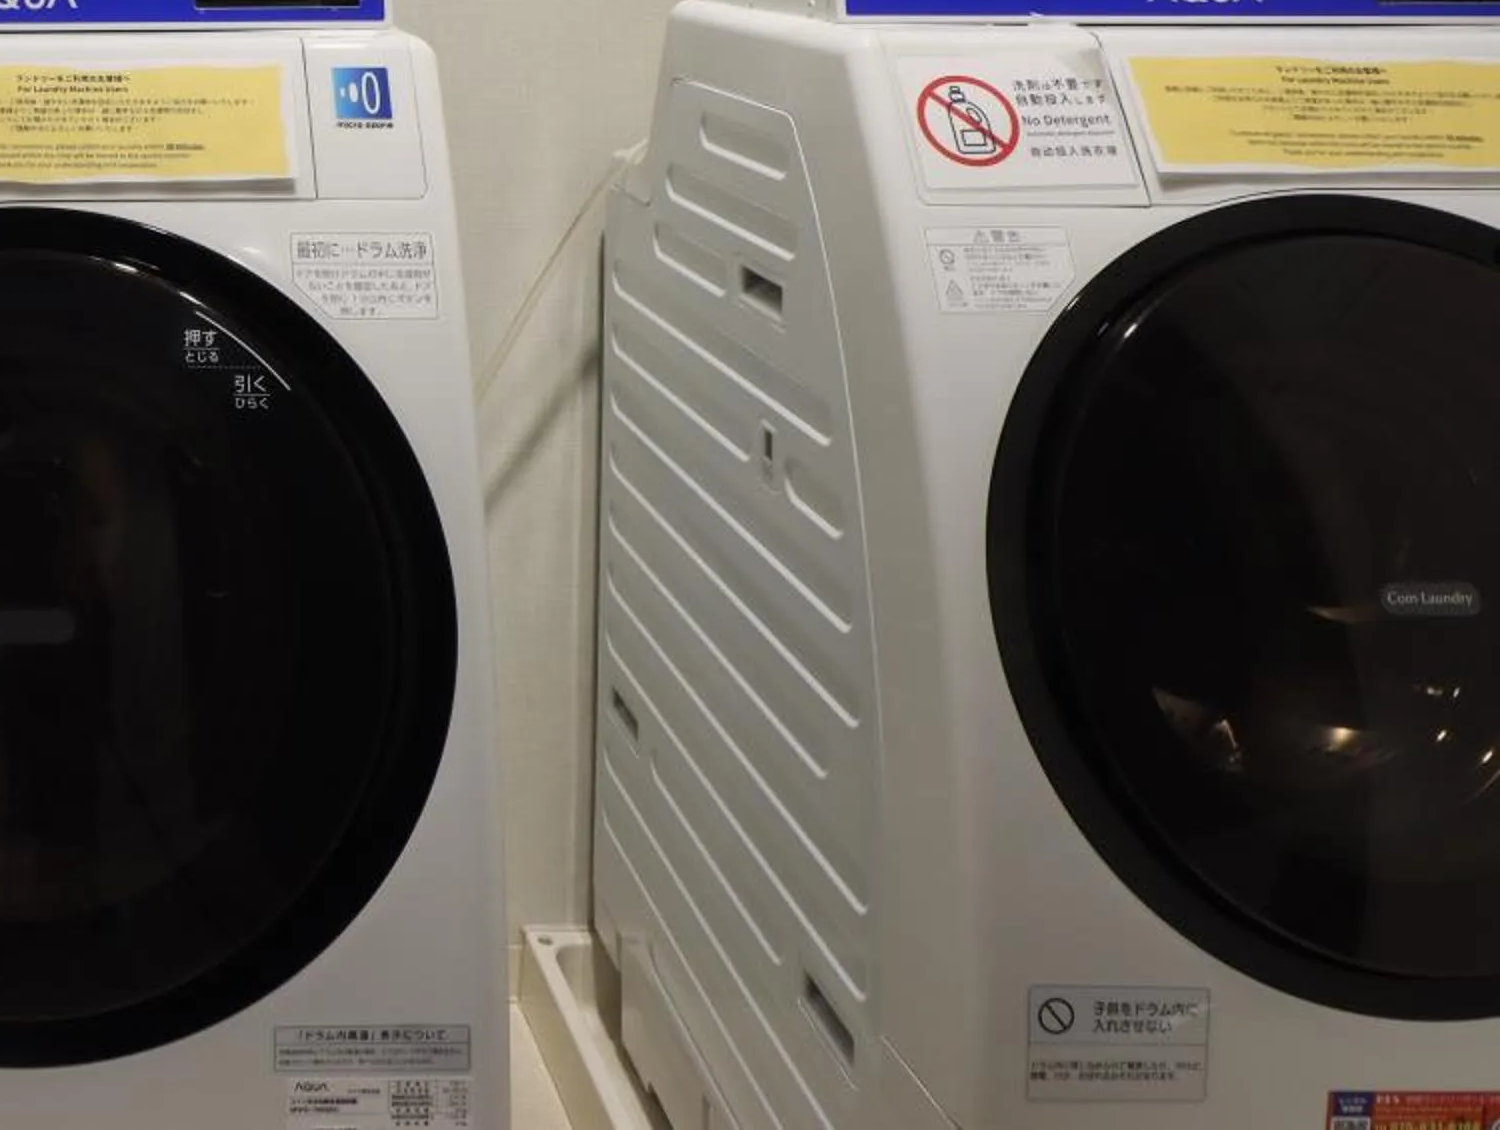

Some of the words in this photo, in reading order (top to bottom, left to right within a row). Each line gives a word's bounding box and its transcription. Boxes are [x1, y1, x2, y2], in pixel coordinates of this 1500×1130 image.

[1021, 115, 1040, 127] No
[1043, 114, 1110, 128] Detergent
[183, 329, 218, 347] 押す
[185, 351, 219, 363] とじる
[234, 373, 267, 393] 引く
[235, 397, 269, 410] ひらく
[1386, 590, 1419, 606] Coin
[1421, 590, 1473, 608] Laundry
[1093, 1019, 1173, 1034] 入れさせない
